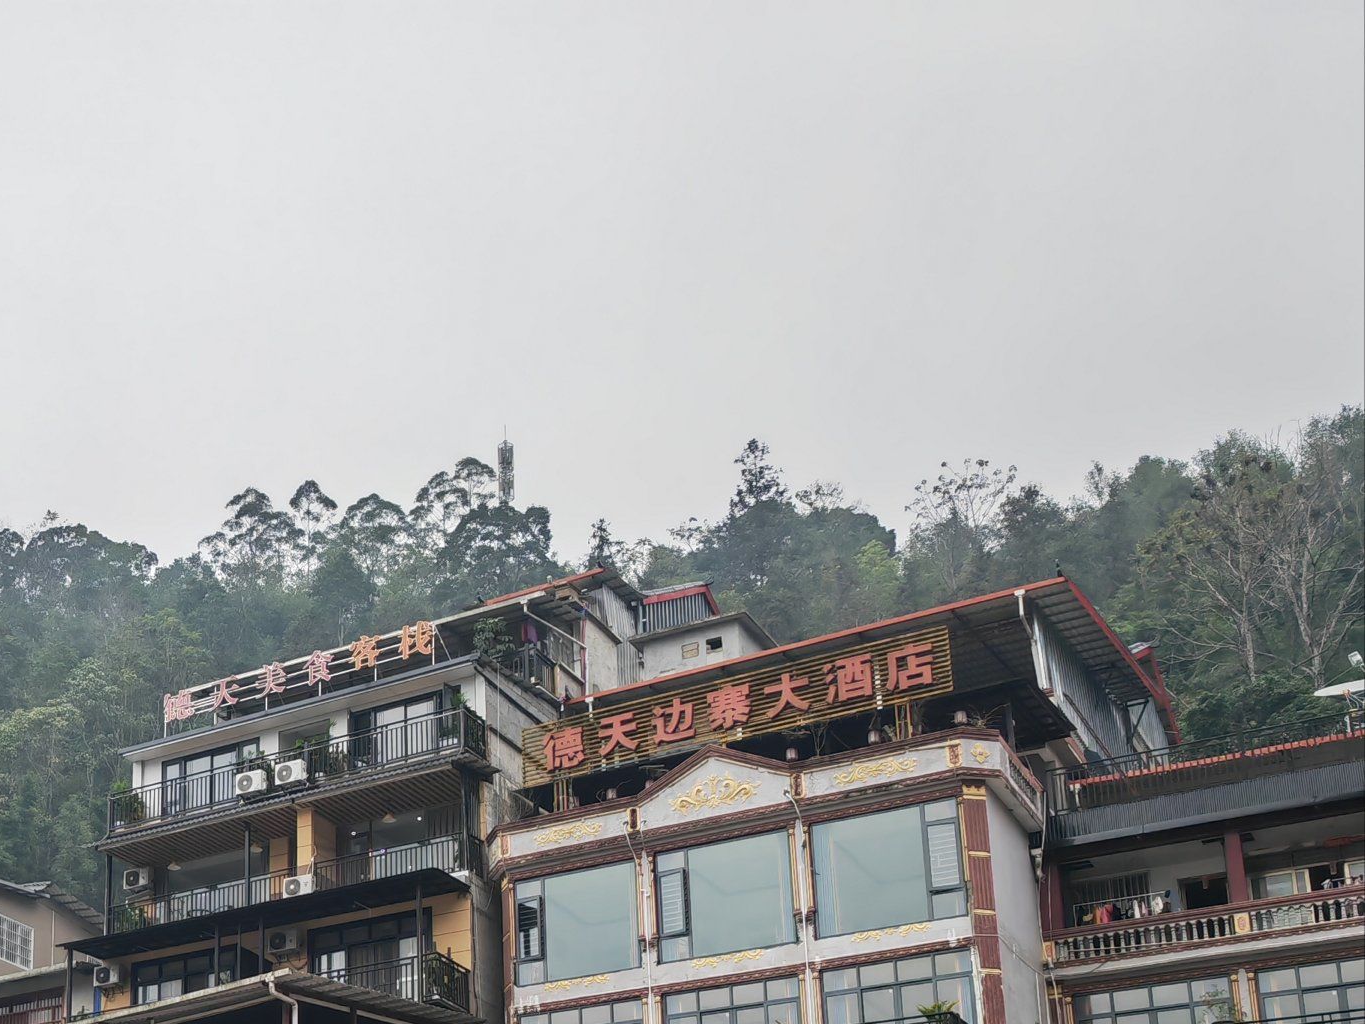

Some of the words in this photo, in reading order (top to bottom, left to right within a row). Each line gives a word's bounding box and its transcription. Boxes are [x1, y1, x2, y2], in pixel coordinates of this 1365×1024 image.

[163, 619, 434, 723] 德天美食客栈
[541, 642, 936, 773] 德天边寨大酒店
